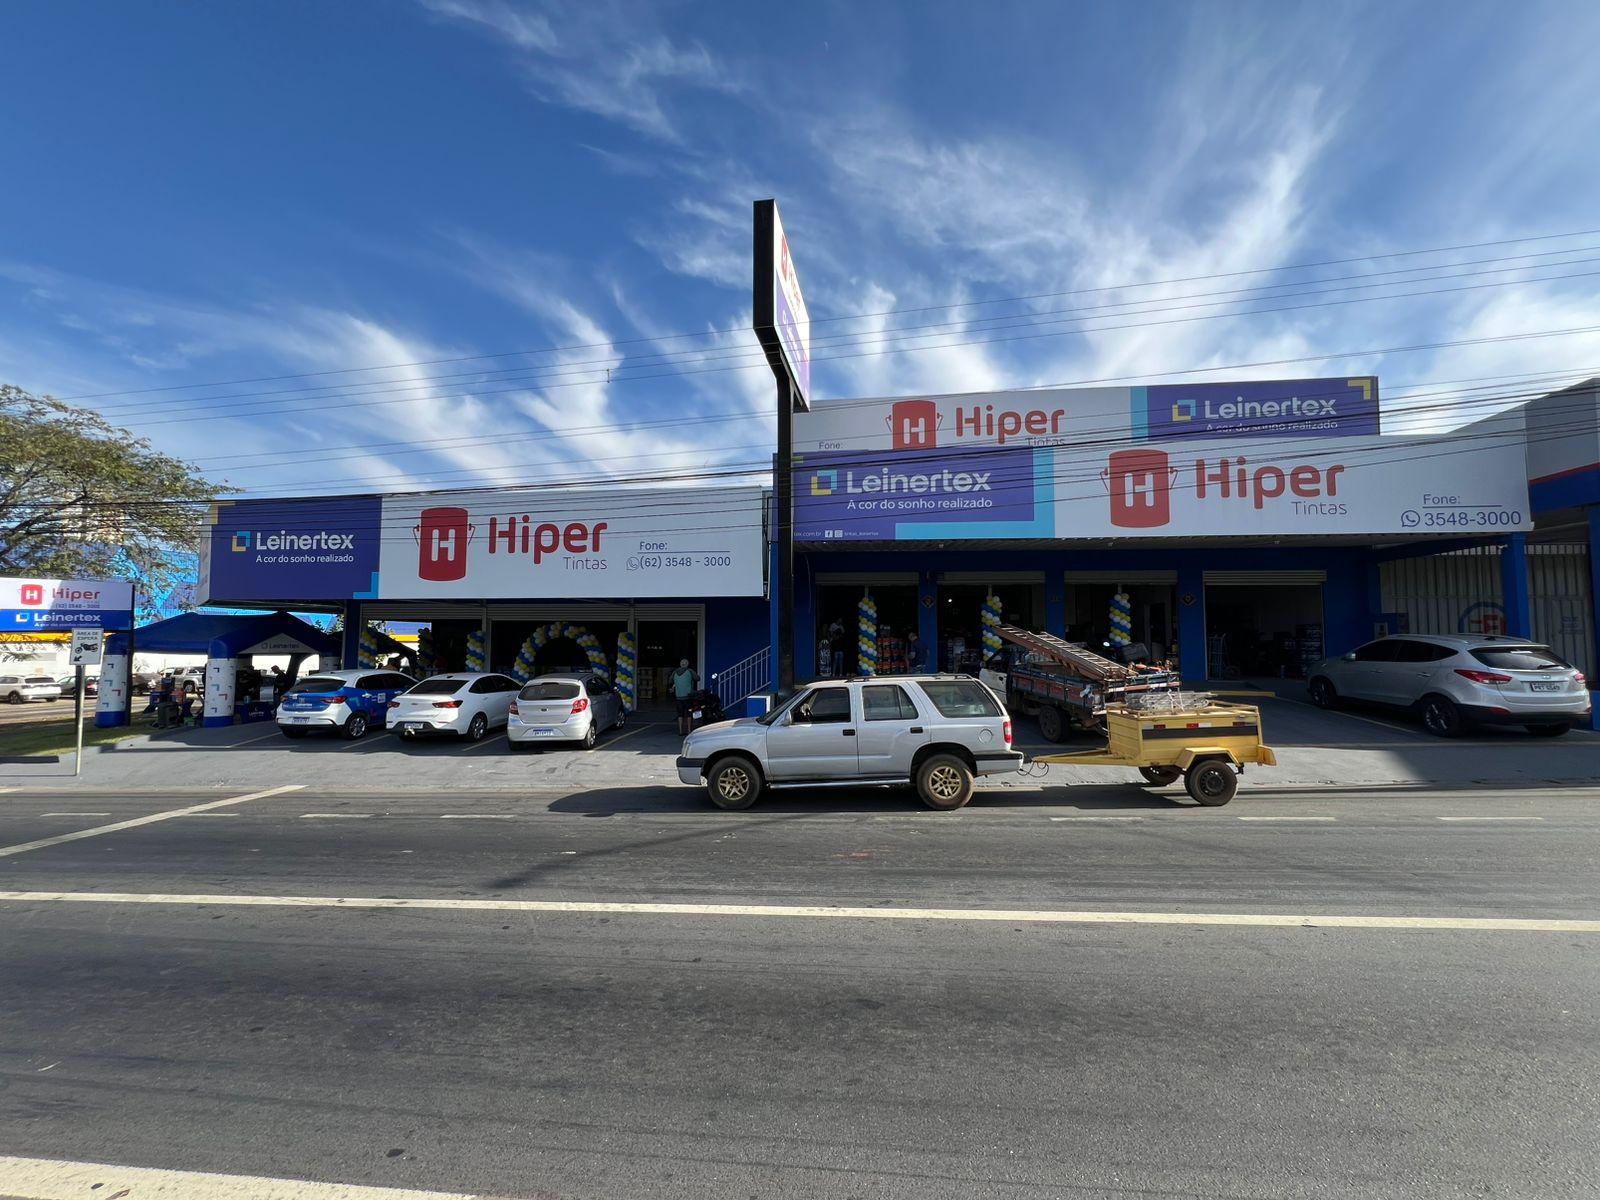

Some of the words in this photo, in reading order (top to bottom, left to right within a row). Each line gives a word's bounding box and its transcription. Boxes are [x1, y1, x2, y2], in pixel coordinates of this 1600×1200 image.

[1204, 396, 1337, 420] Leinertex
[955, 404, 1065, 444] Hiper
[818, 440, 844, 450] Fone:
[1024, 436, 1065, 448] Tintas
[846, 467, 992, 494] Leinertex
[1196, 455, 1345, 510] Hiper
[847, 500, 856, 509] A
[858, 500, 877, 509] cor
[880, 499, 895, 509] do
[897, 498, 935, 509] sonho
[937, 497, 993, 508] realizado
[1422, 493, 1461, 505] Fone:
[1291, 501, 1348, 515] Tintas
[1424, 510, 1522, 526] 3548-3000
[256, 529, 354, 551] Leinertex
[488, 514, 608, 565] Hiper
[639, 540, 668, 551] Fone:
[255, 555, 263, 563] A
[278, 554, 289, 563] do
[290, 554, 316, 563] sonho
[317, 553, 354, 563] realizado
[564, 556, 608, 571] Tintas
[640, 556, 662, 569] (62)
[665, 556, 692, 568] 3548
[703, 556, 732, 568] 3000
[52, 587, 101, 602] Hiper
[33, 612, 102, 622] Leinertex
